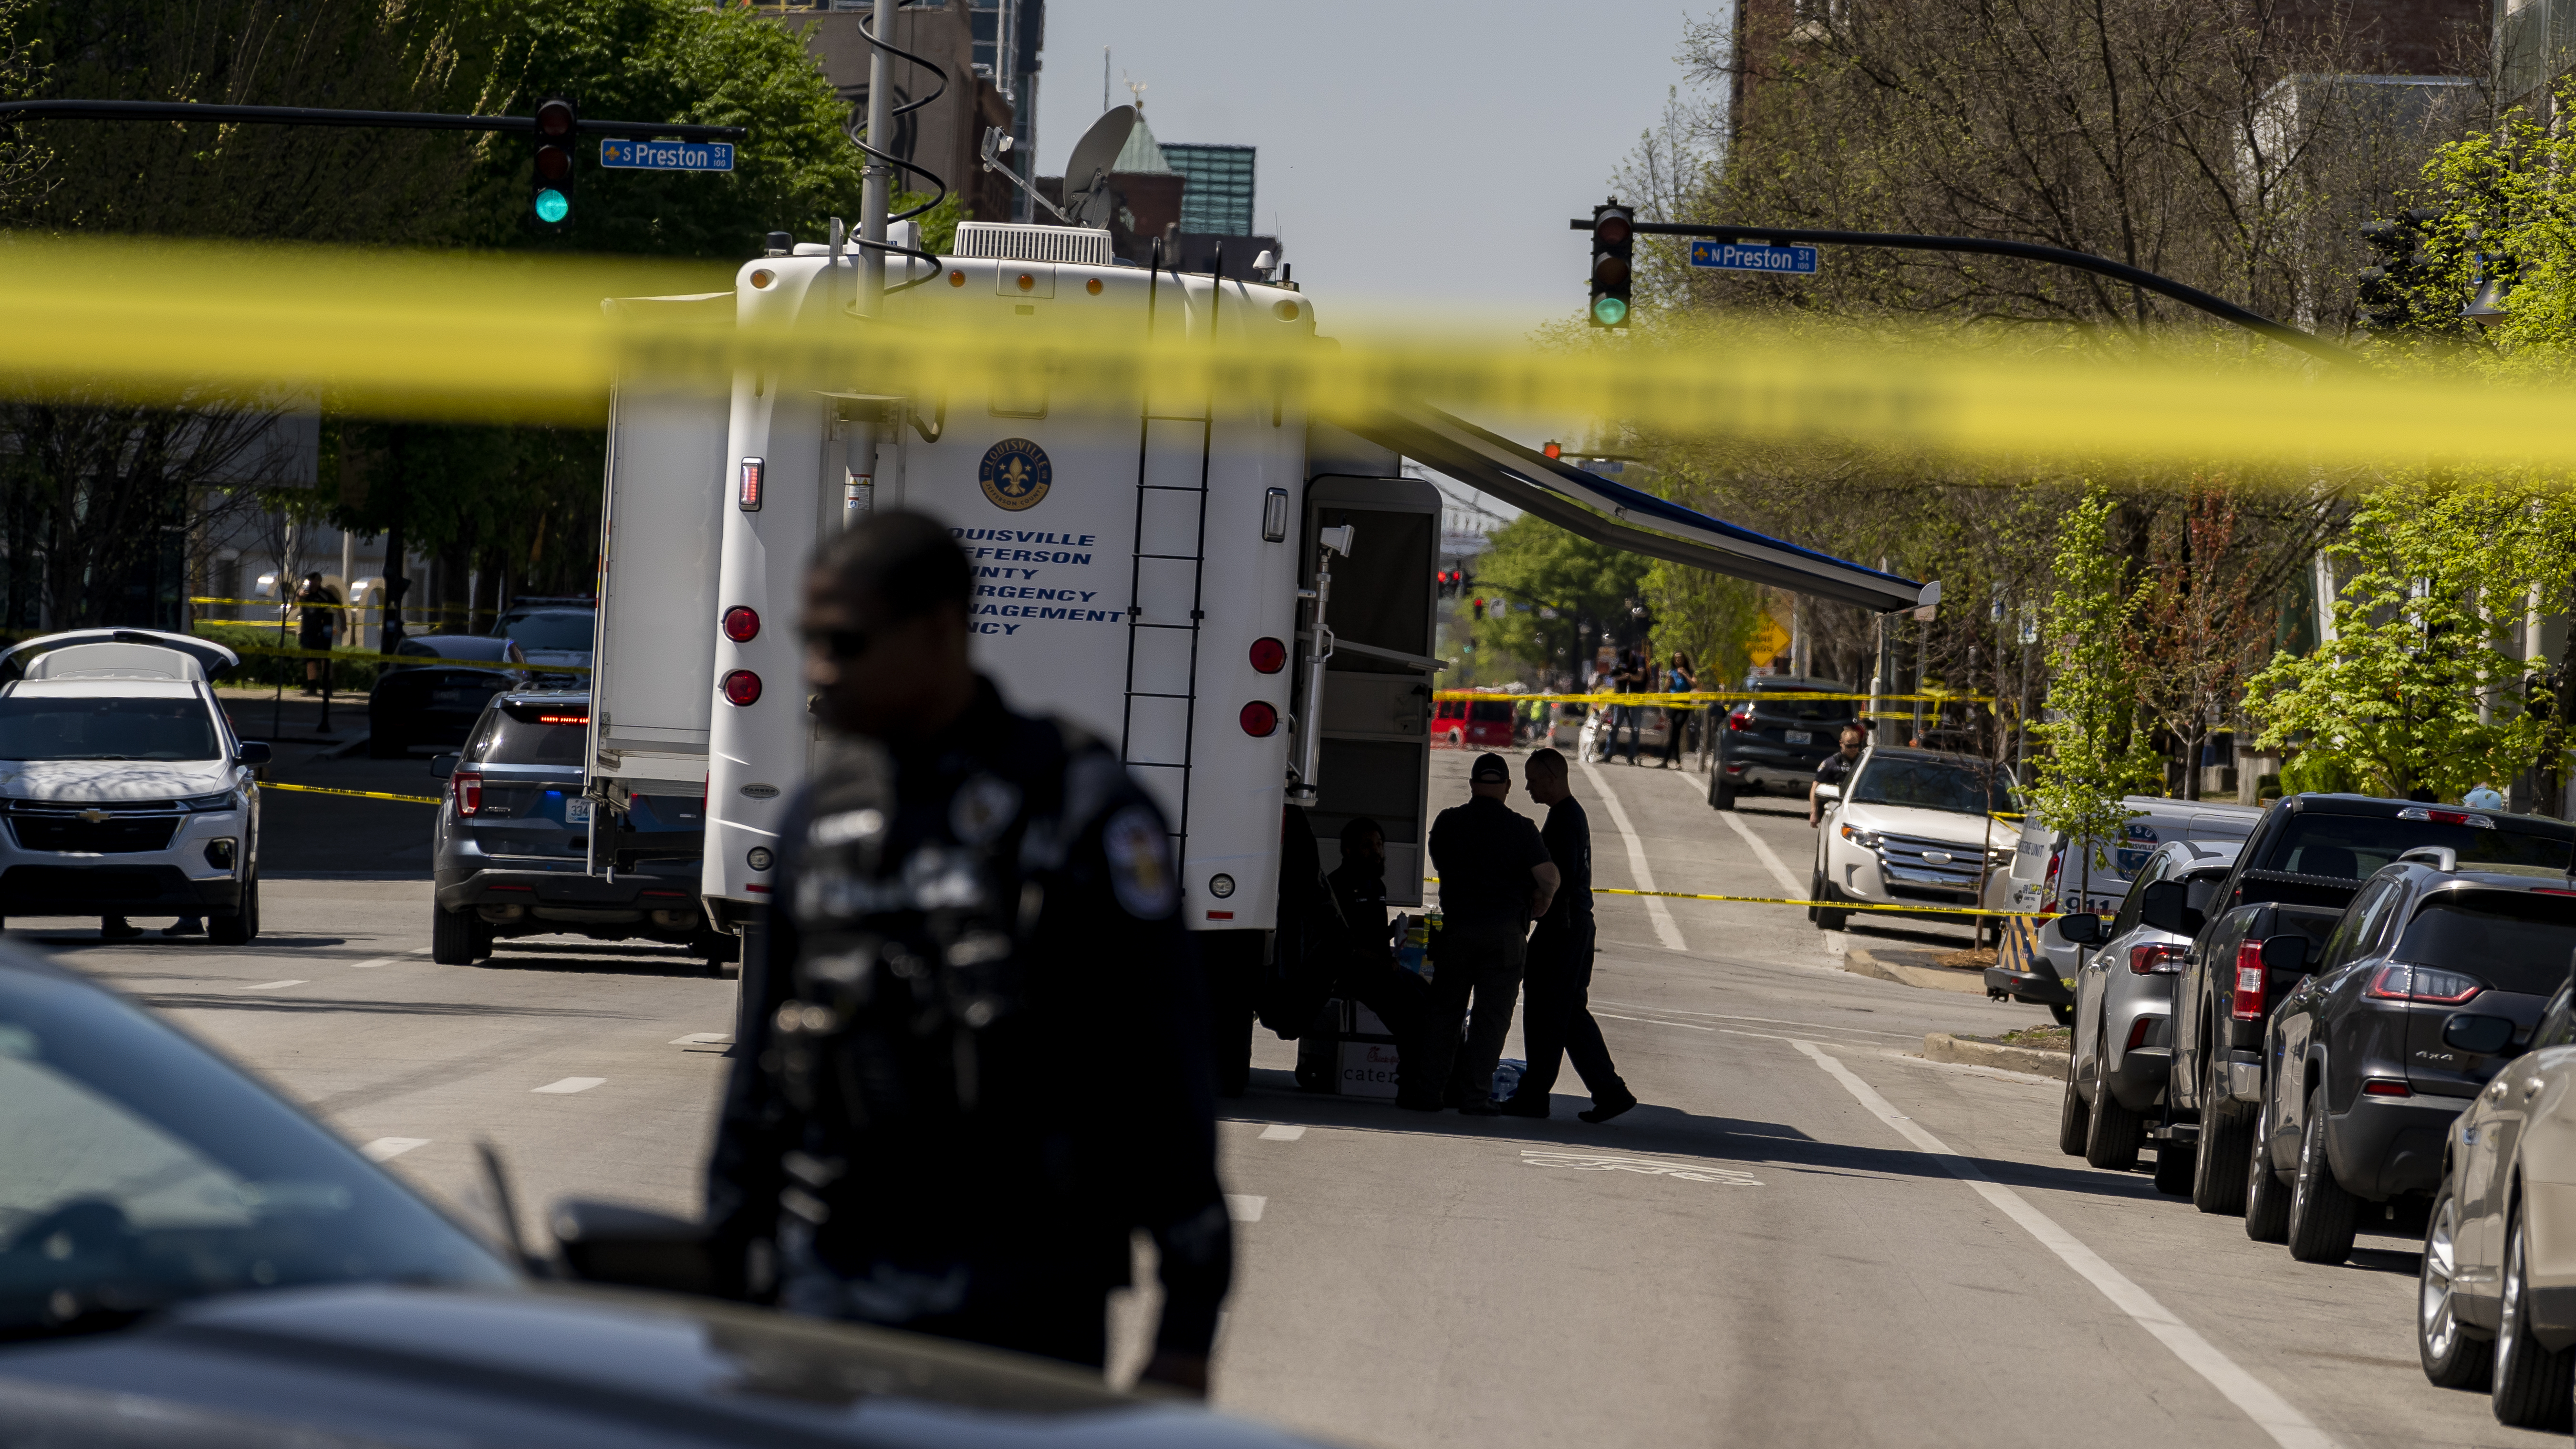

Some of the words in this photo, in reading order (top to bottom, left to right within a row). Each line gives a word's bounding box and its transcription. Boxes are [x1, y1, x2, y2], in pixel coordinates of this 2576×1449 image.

[623, 147, 631, 161] S
[636, 144, 707, 167] Preston
[714, 147, 726, 158] St
[713, 159, 726, 167] 100
[1712, 249, 1720, 261] N
[1724, 246, 1792, 269] Preston
[1798, 250, 1809, 261] St
[985, 440, 1048, 468] LOUISVILLE
[986, 483, 1017, 506] JEFFERSON
[1020, 485, 1043, 505] COUNTY
[947, 527, 1096, 547] OUISVILLE
[959, 547, 1092, 565] FFERSON
[968, 603, 1125, 623] NAGEMENT
[967, 622, 1022, 636] NCY
